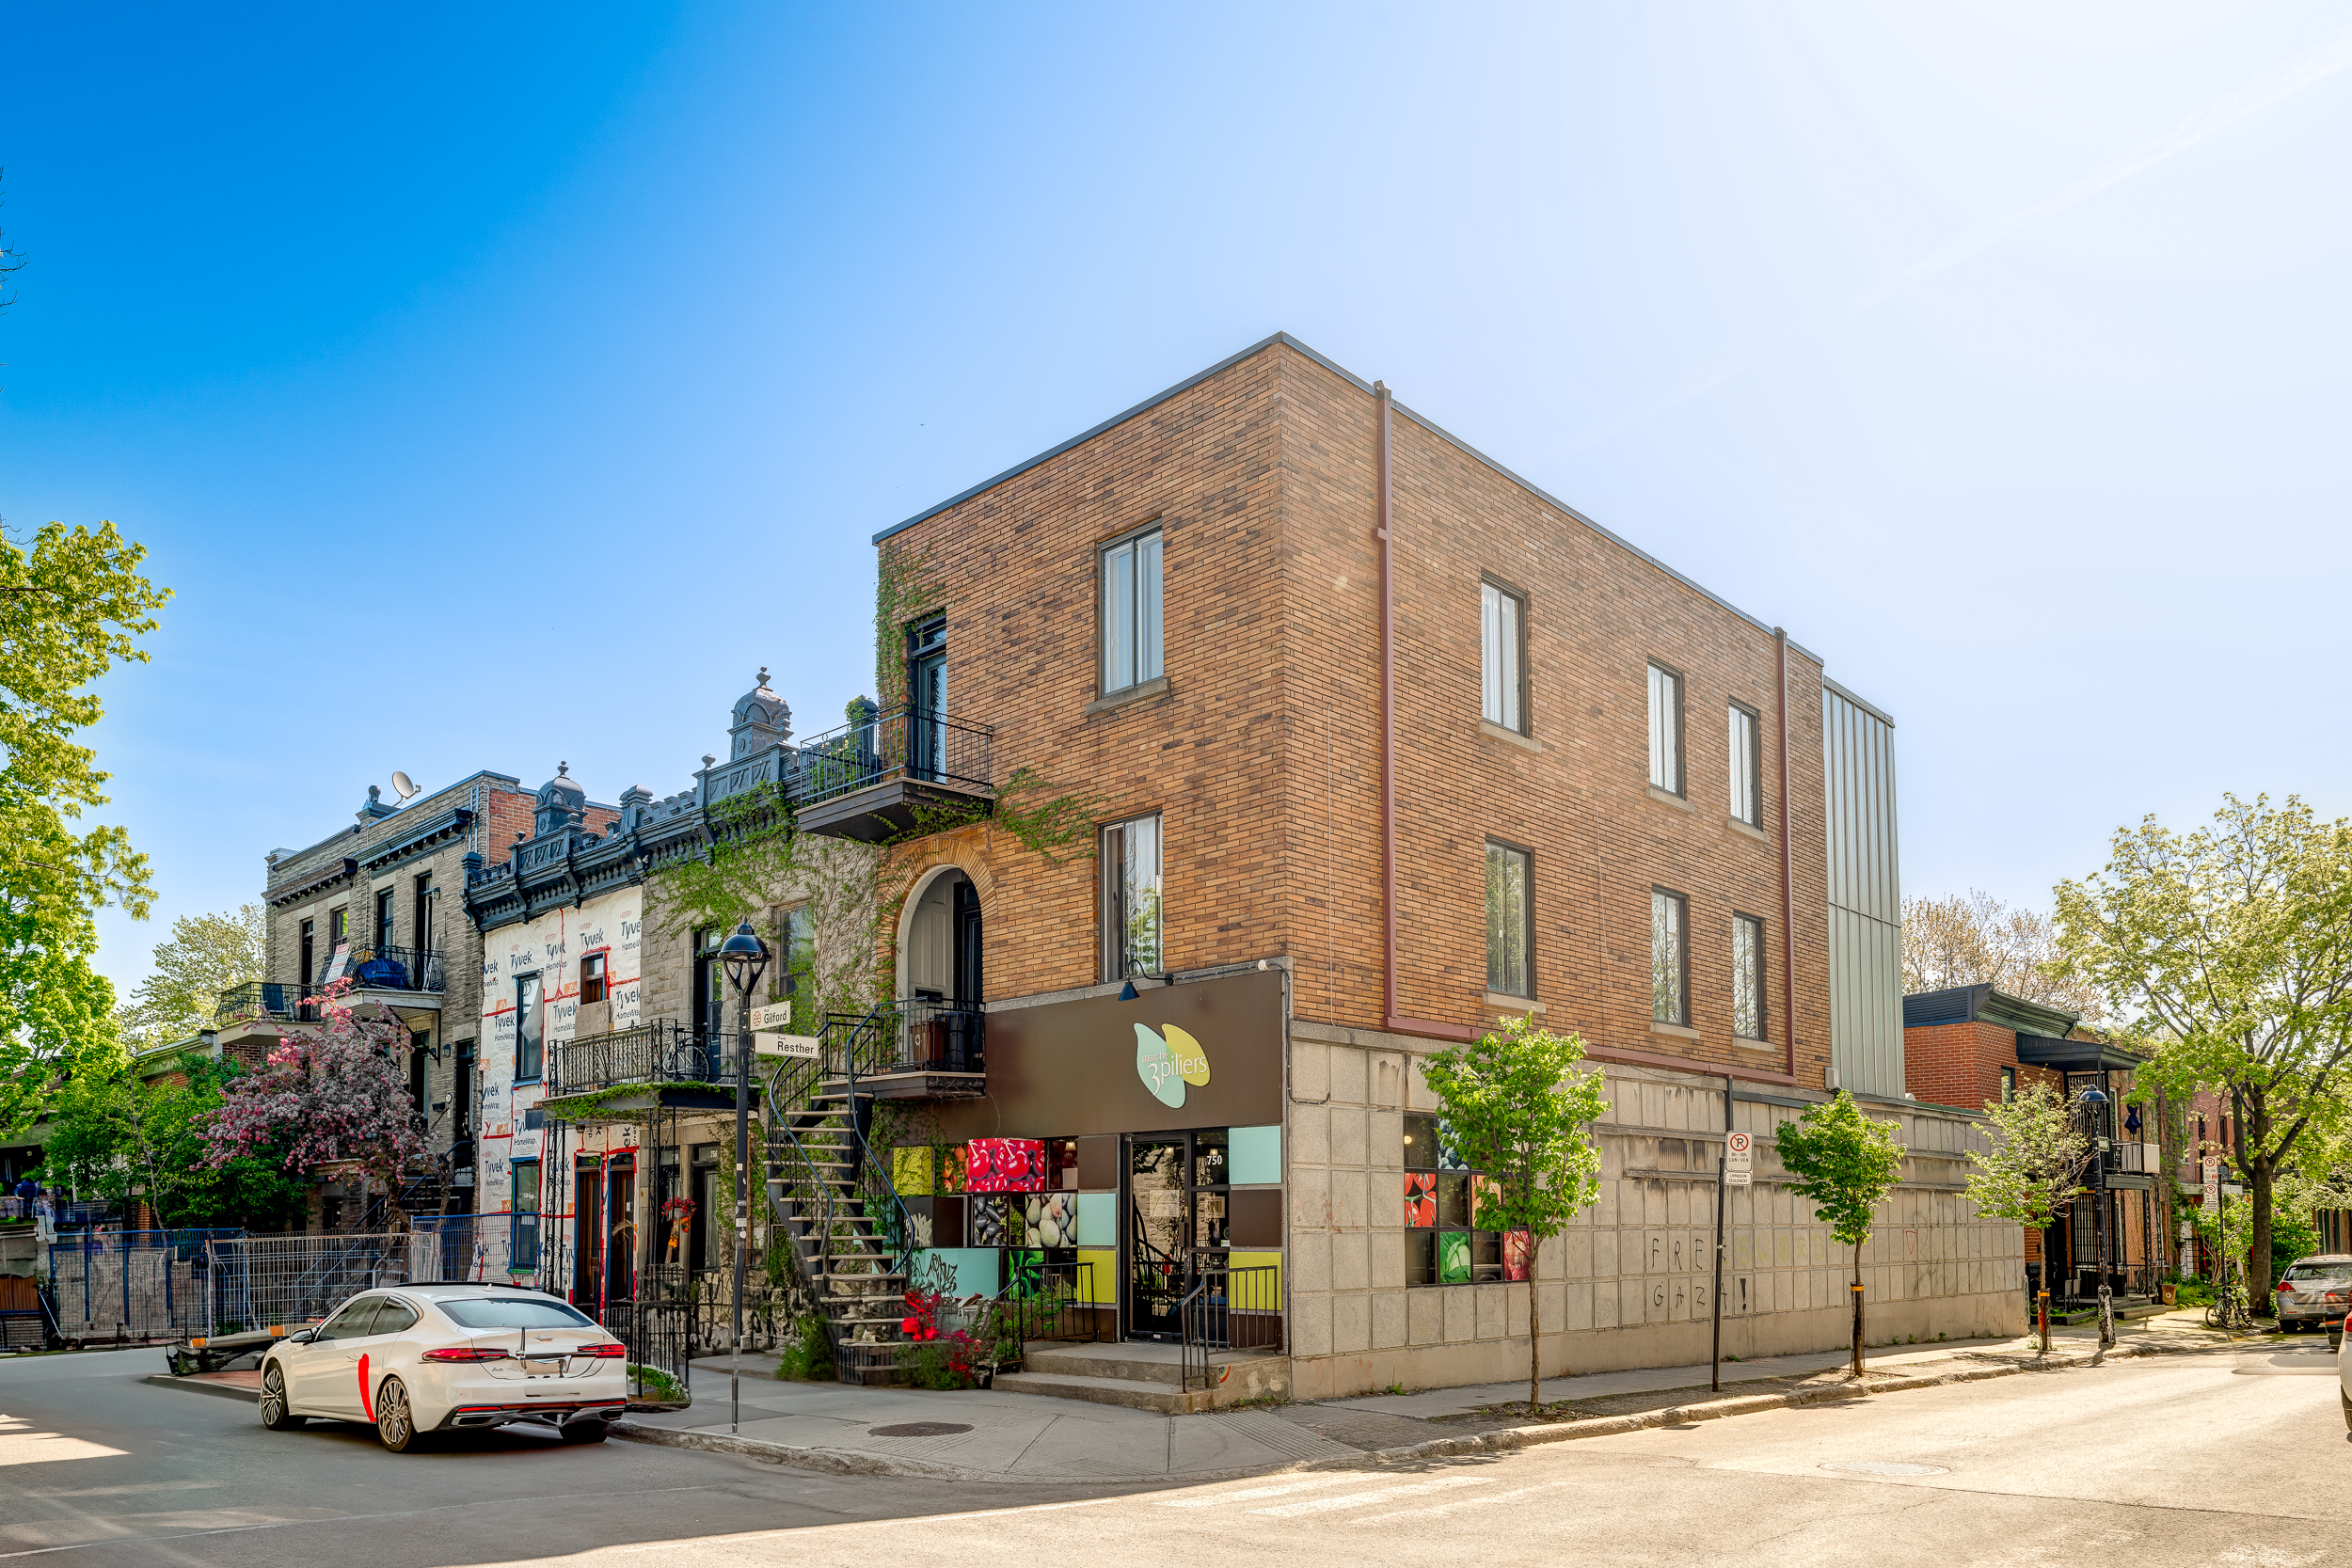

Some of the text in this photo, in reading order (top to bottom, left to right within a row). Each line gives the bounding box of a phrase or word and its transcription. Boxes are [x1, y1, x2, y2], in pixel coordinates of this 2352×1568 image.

[580, 927, 604, 950] Tyvek
[621, 921, 641, 940] Tyve
[484, 959, 499, 974] vek
[510, 950, 532, 971] Tyvek
[494, 1013, 516, 1032] Tyvek
[764, 1010, 787, 1024] Gilford
[553, 1022, 576, 1033] HomeWra
[777, 1040, 815, 1054] Resther
[1141, 1051, 1168, 1063] marché
[482, 1083, 500, 1101] yvek
[1206, 1155, 1223, 1165] 750
[485, 1159, 504, 1178] Tyvek
